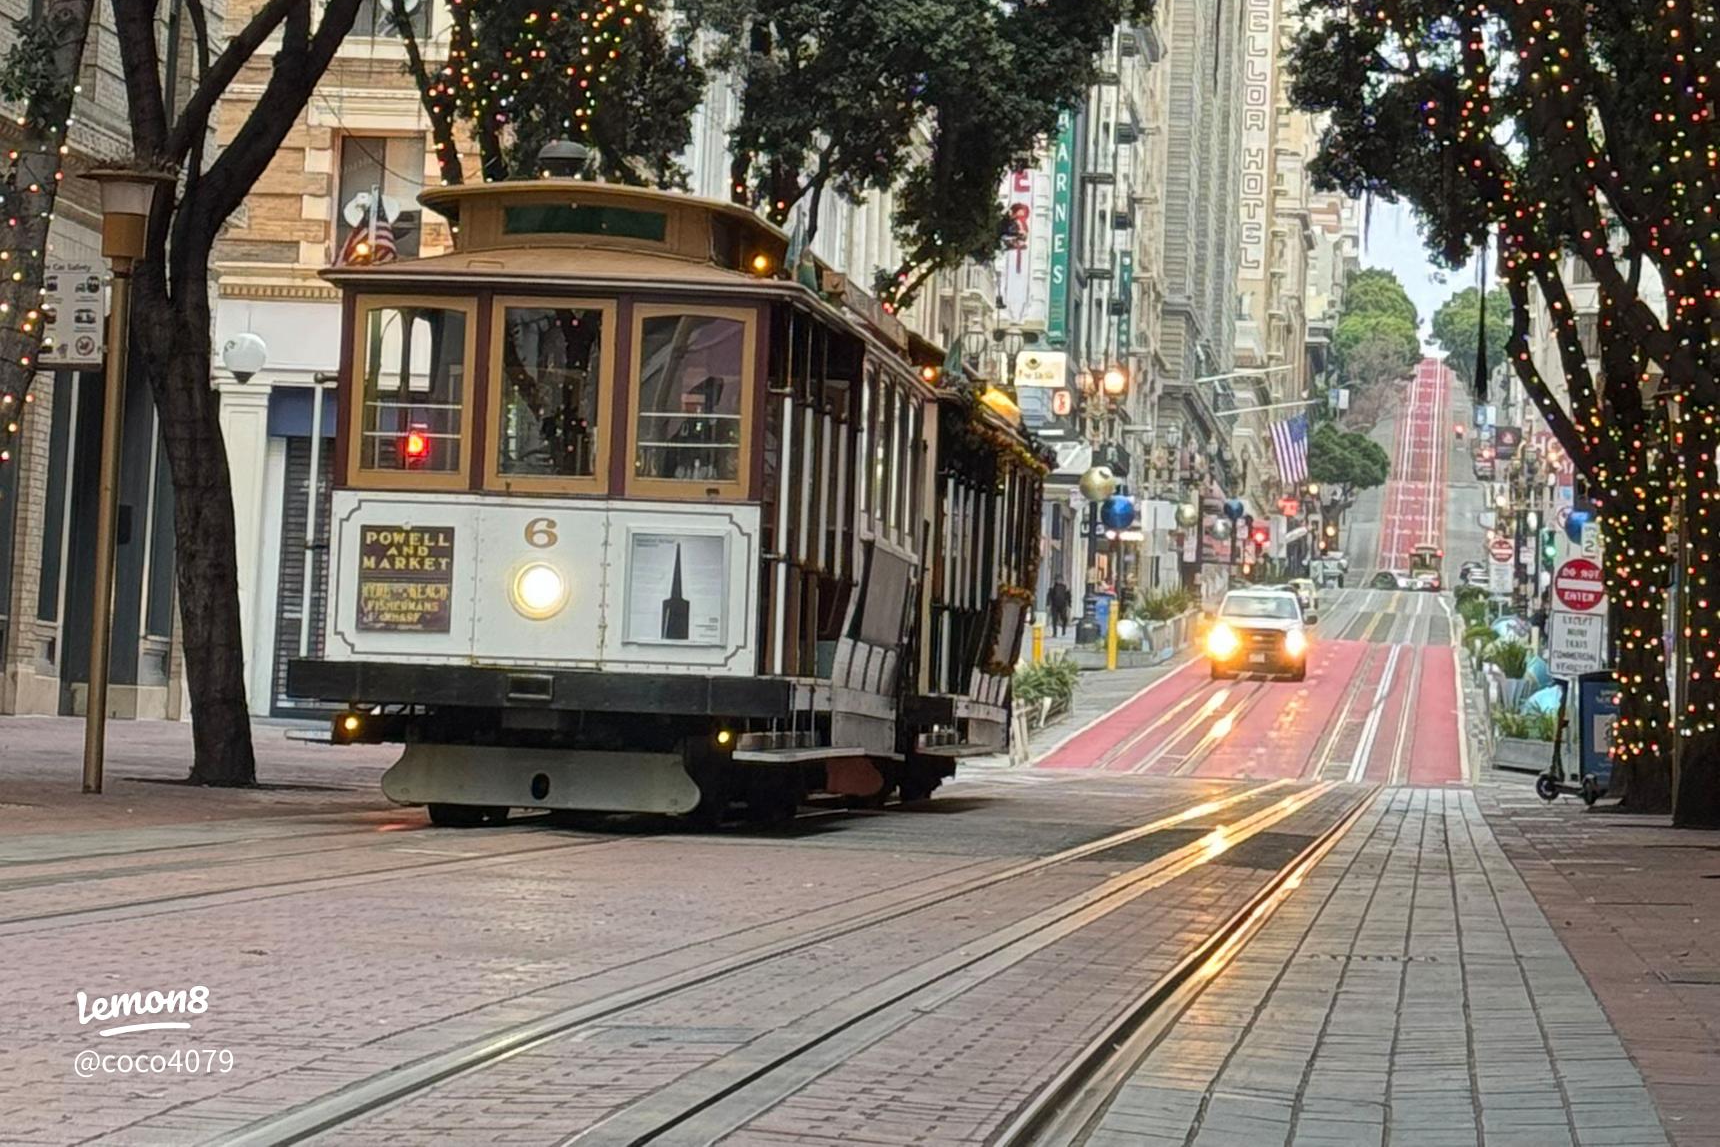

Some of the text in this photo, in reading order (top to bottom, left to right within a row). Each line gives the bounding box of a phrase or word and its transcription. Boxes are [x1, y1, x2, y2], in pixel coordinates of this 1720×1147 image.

[1240, 147, 1265, 270] HOTEL
[366, 531, 451, 547] POWELL
[524, 517, 558, 550] 6
[385, 546, 429, 557] AND
[362, 555, 451, 571] MARKET
[1562, 567, 1601, 580] DO NOT
[1563, 591, 1595, 603] ENTER
